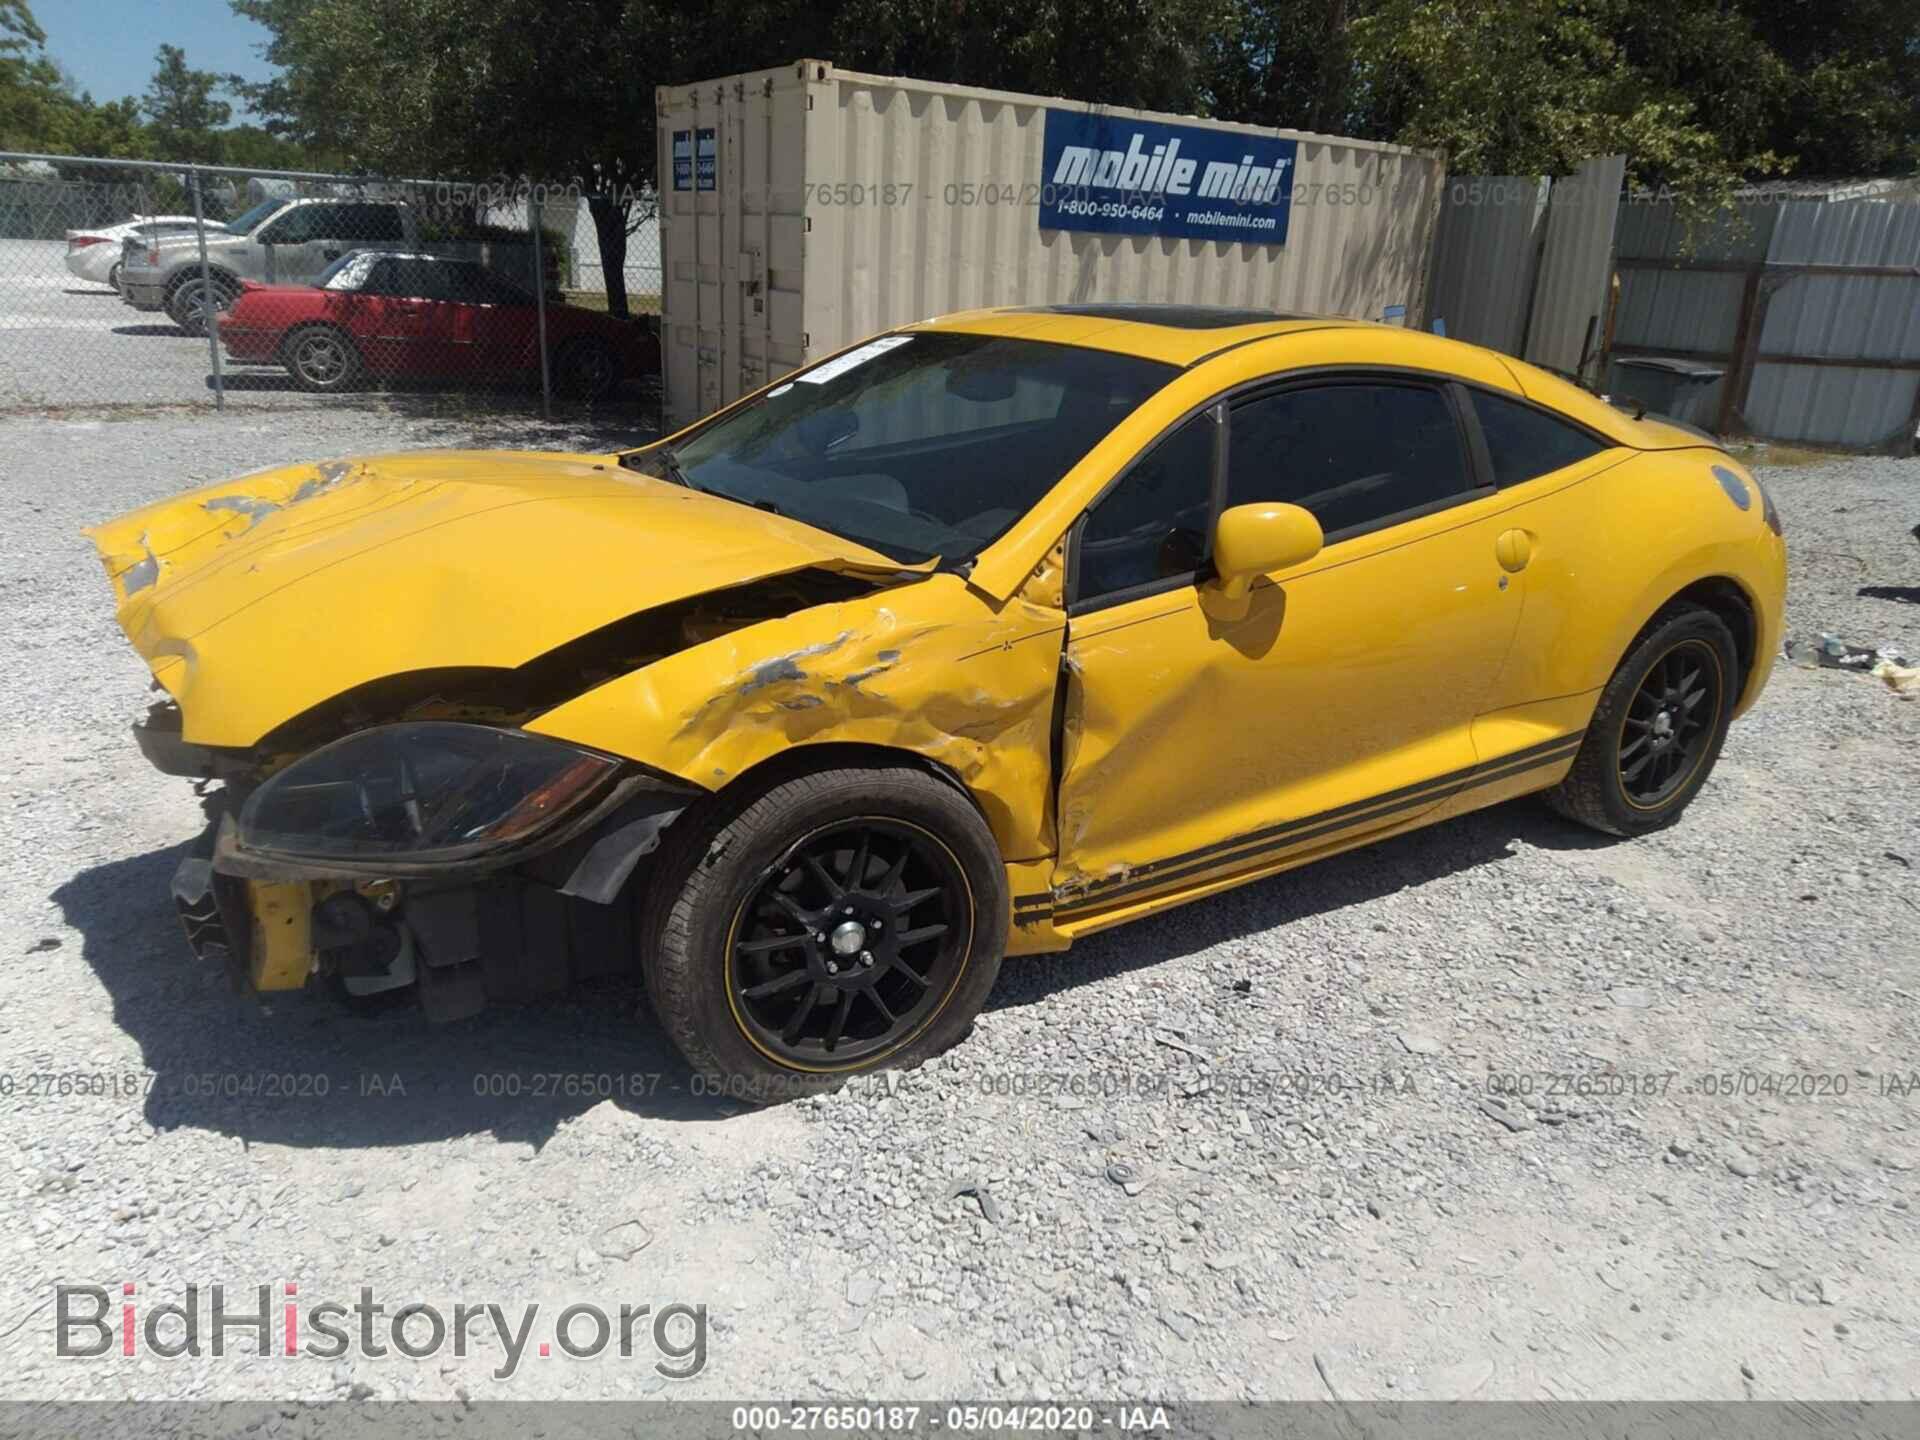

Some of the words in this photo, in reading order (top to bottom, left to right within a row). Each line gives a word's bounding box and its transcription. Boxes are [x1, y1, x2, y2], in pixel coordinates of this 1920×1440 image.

[1053, 133, 1197, 196] mobile
[1197, 154, 1287, 201] mini
[1057, 200, 1164, 222] 1-800-950-6464
[1187, 211, 1276, 229] mobilemini.com
